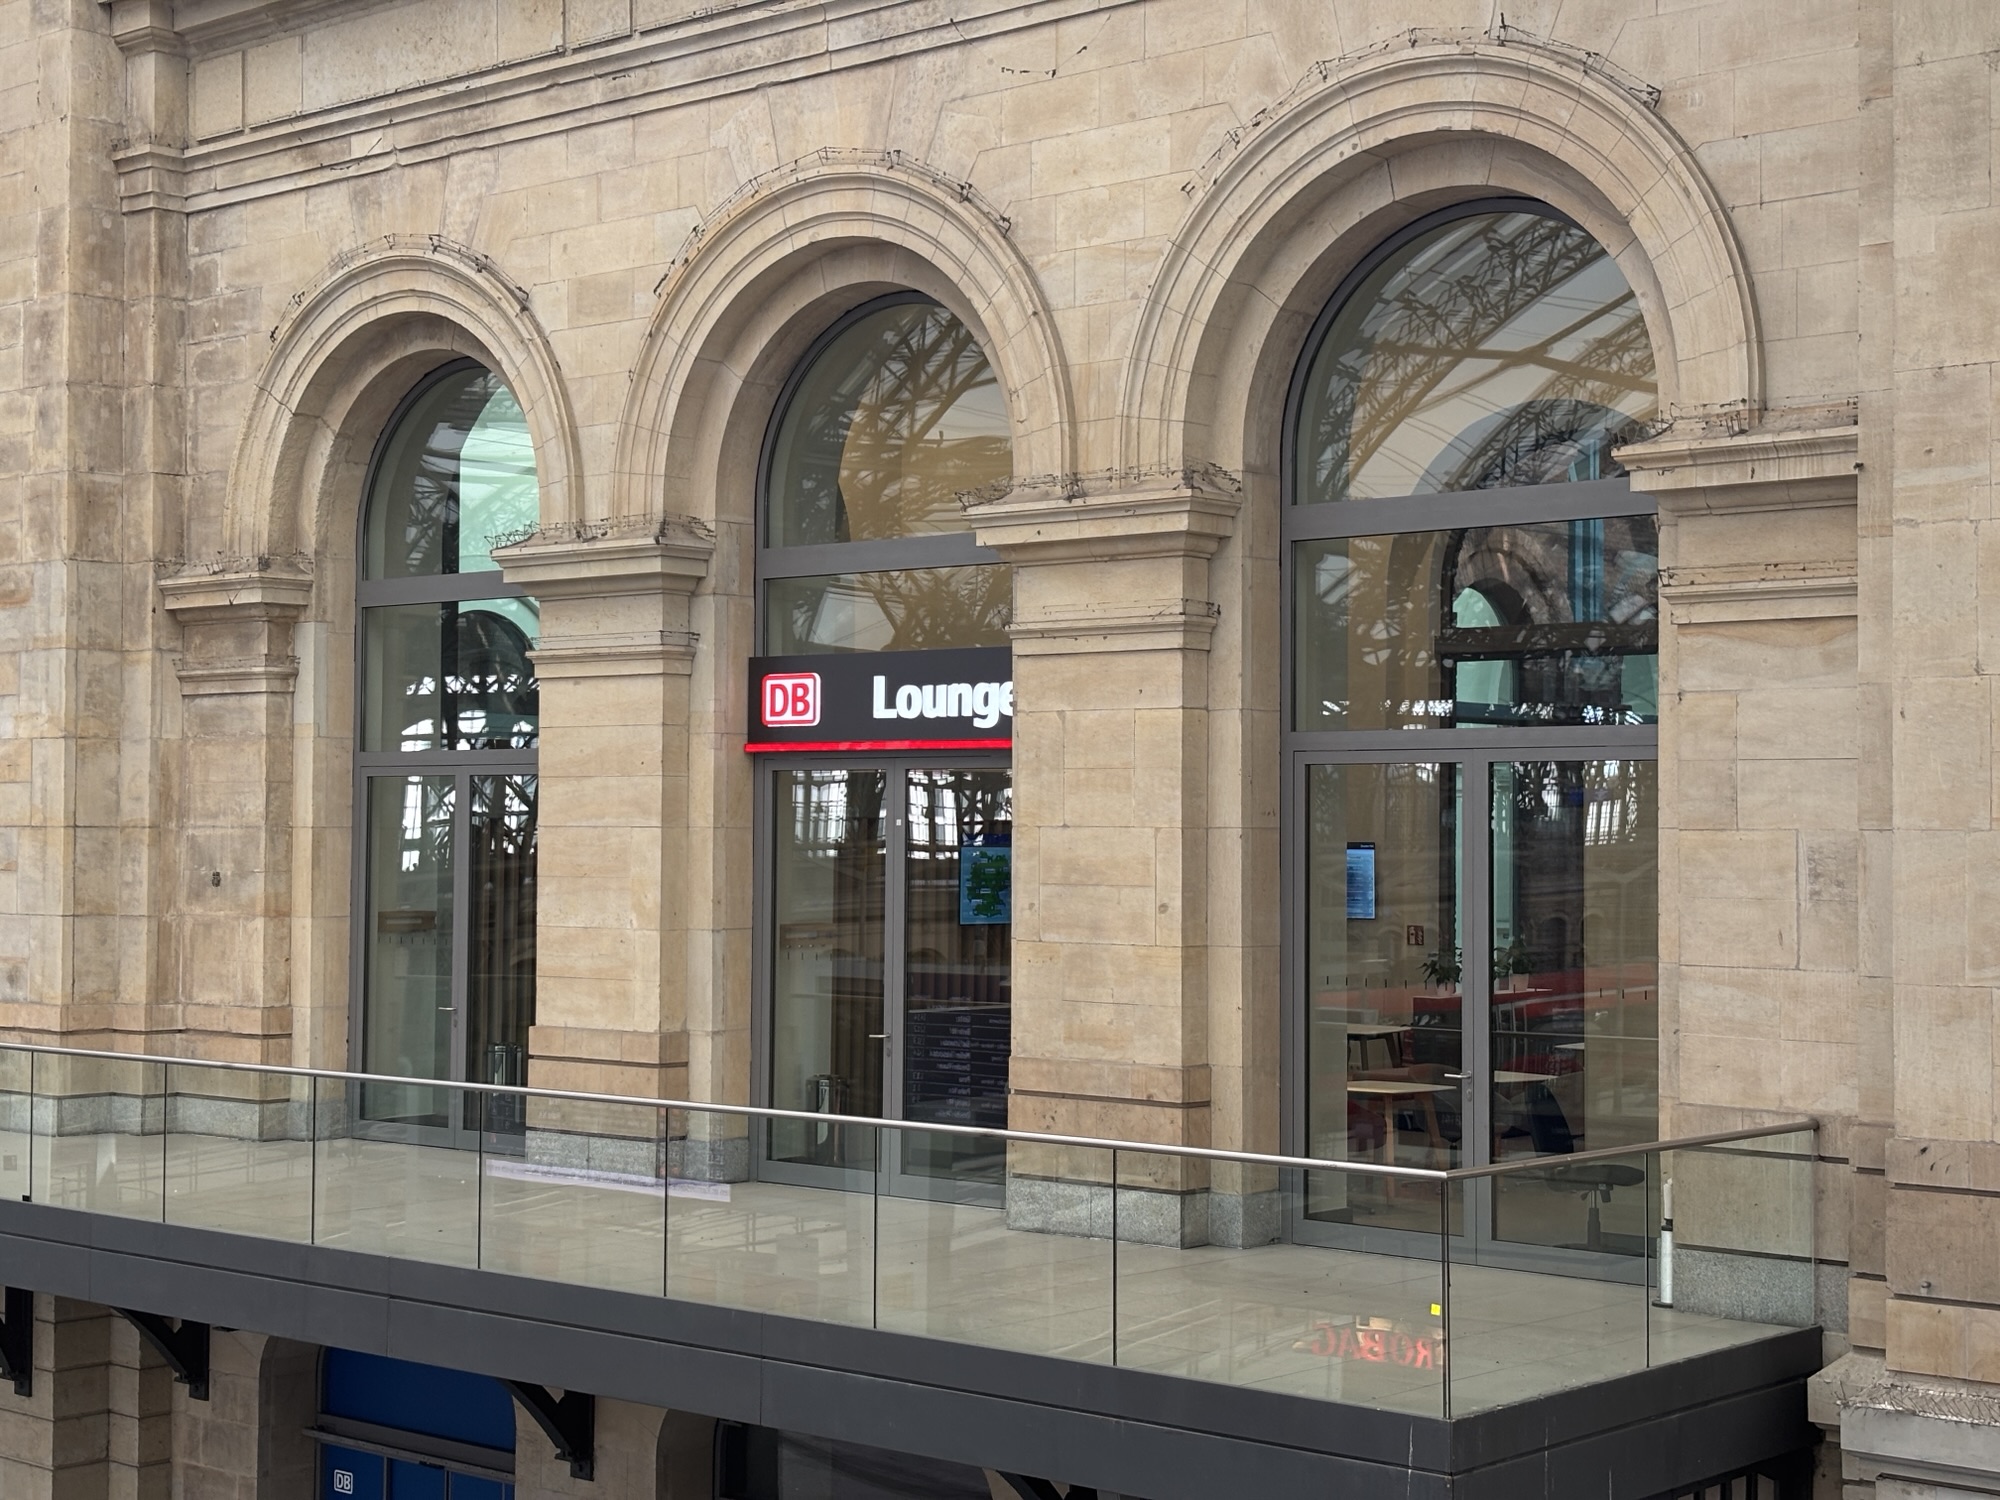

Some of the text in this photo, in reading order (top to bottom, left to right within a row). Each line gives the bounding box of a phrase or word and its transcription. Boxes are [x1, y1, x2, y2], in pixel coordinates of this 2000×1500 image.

[769, 675, 1013, 729] DB Lounge
[336, 1473, 351, 1490] DB
